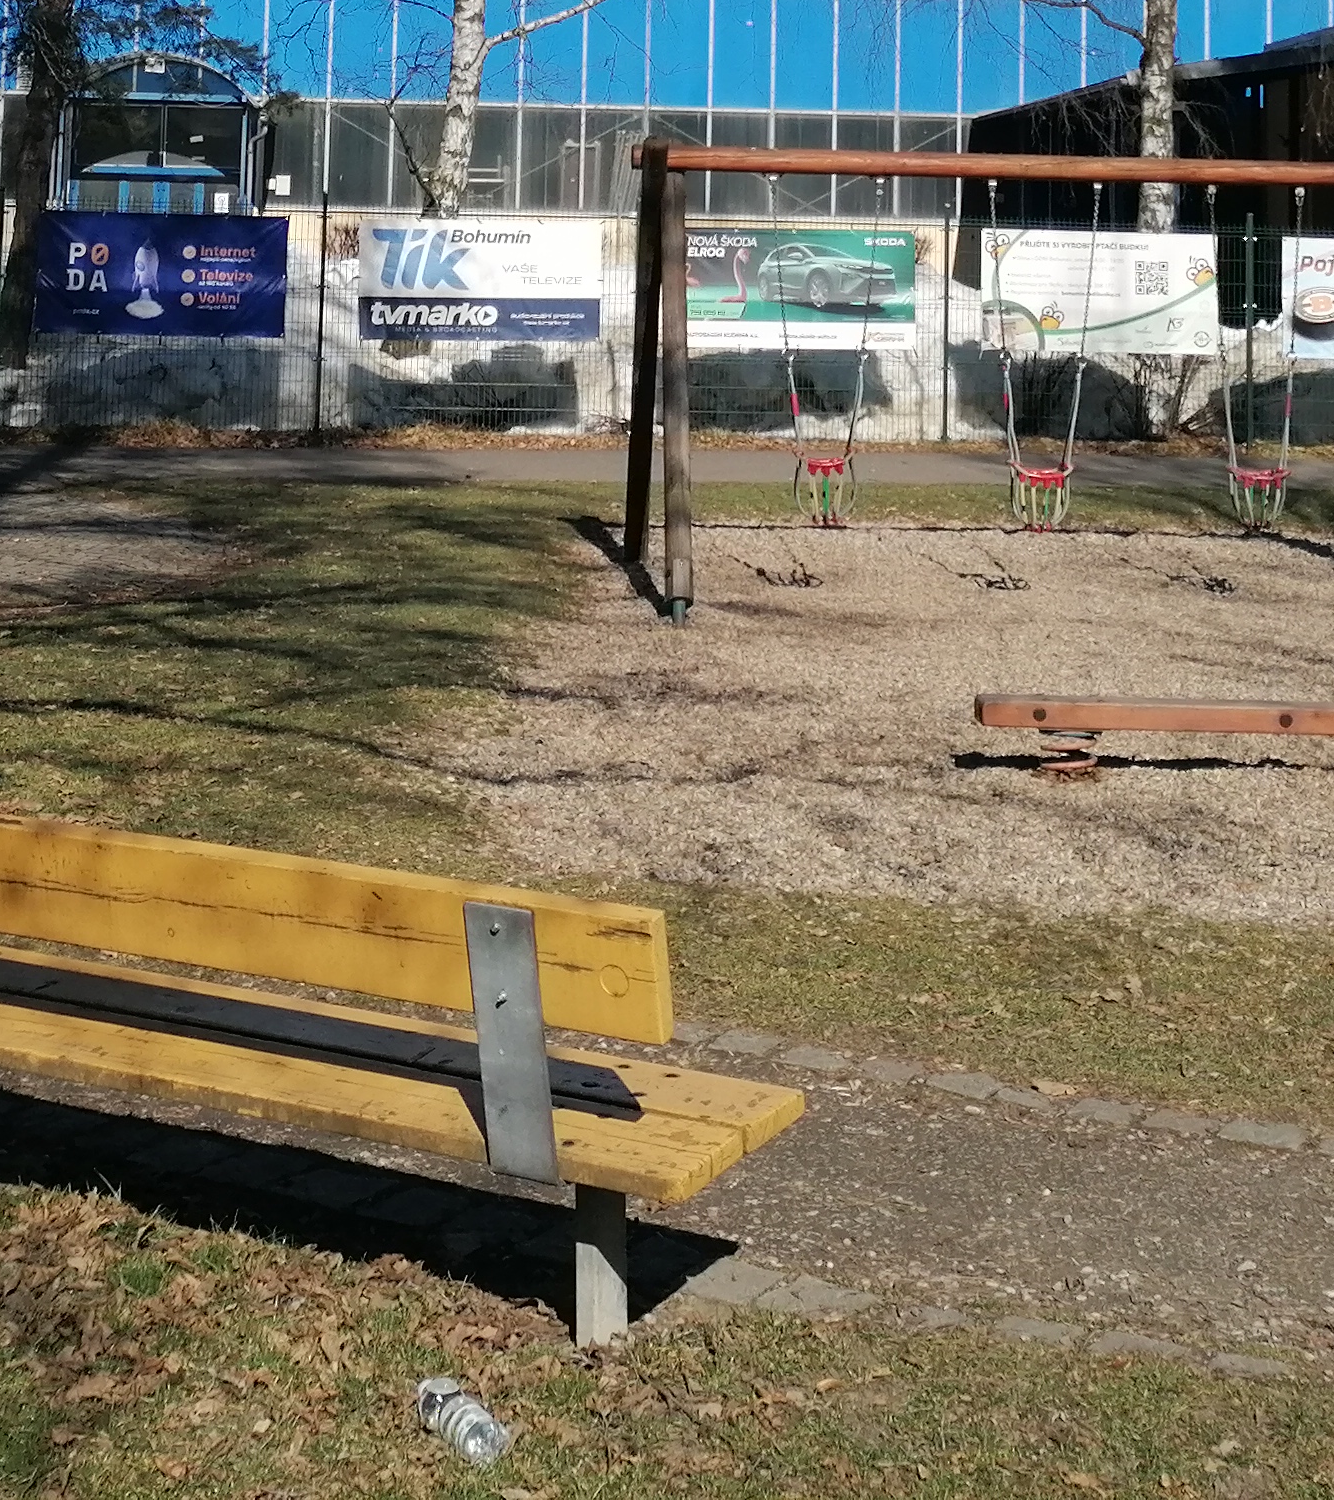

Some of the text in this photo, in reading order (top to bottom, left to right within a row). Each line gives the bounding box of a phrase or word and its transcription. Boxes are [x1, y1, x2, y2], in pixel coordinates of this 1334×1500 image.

[451, 229, 531, 244] Bohumín
[687, 233, 757, 248] NOVÁ ŠKODA
[200, 245, 256, 258] Internet
[687, 246, 725, 258] ELROQ
[502, 263, 537, 273] VAŠE
[199, 268, 254, 282] Televize
[522, 276, 583, 286] TELEVIZE
[198, 291, 241, 304] Volání
[371, 301, 497, 326] tvmarko
